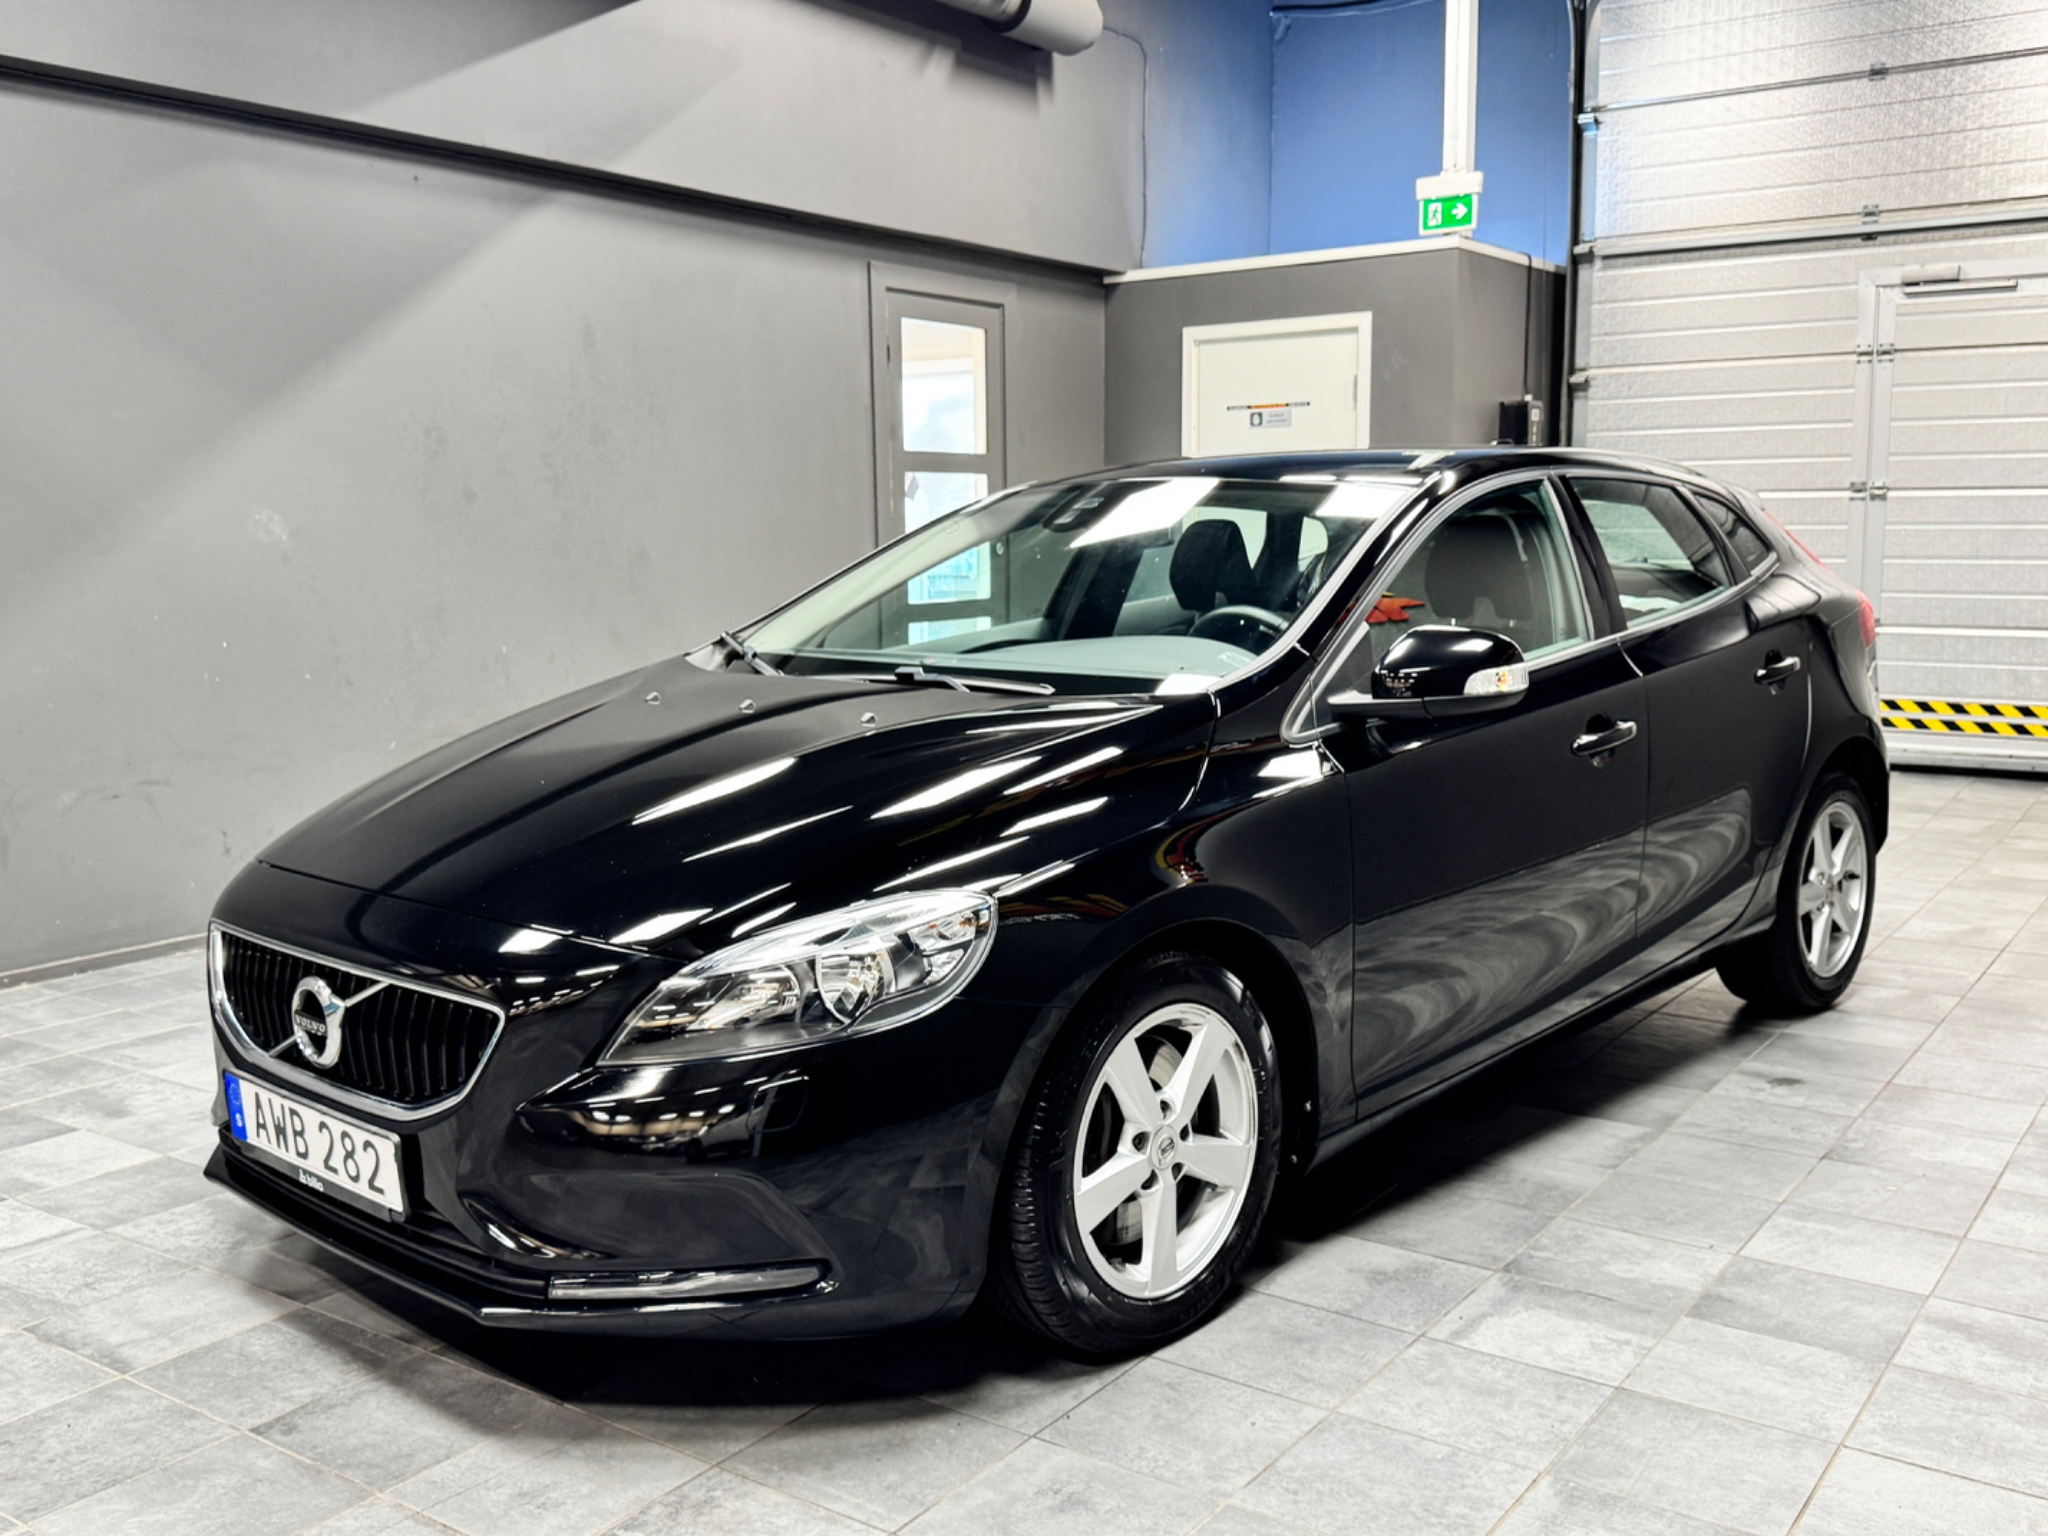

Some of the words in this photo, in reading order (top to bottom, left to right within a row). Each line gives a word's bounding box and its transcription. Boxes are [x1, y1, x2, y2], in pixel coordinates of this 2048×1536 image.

[295, 1014, 326, 1033] VOLVO
[235, 1112, 243, 1128] S
[254, 1091, 309, 1161] AWB
[318, 1120, 385, 1197] 282
